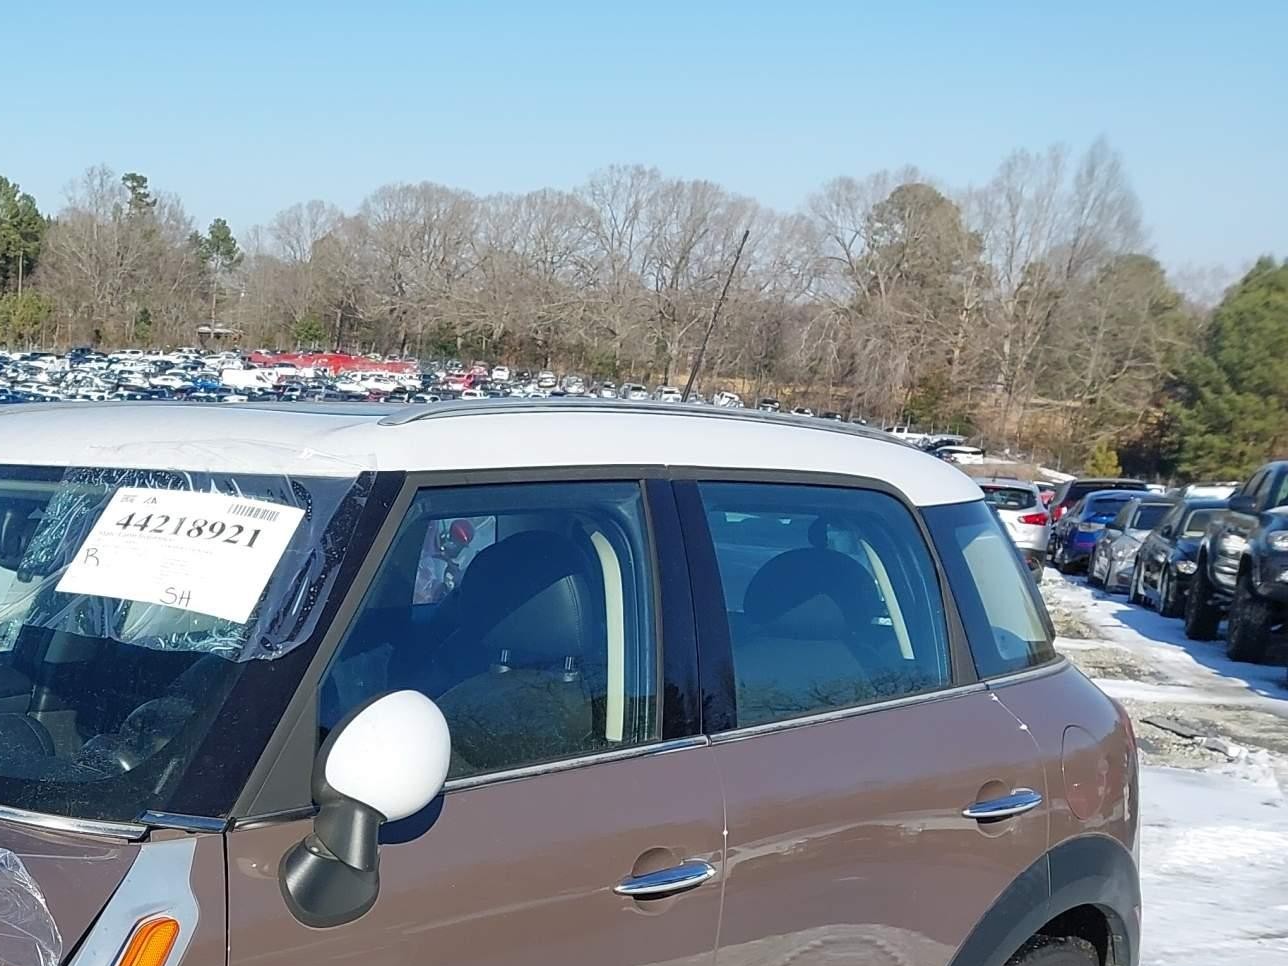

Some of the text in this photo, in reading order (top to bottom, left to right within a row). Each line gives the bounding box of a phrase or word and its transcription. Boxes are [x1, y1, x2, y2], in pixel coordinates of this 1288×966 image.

[115, 511, 262, 549] 44218921
[83, 547, 100, 567] R
[159, 586, 192, 607] SH
